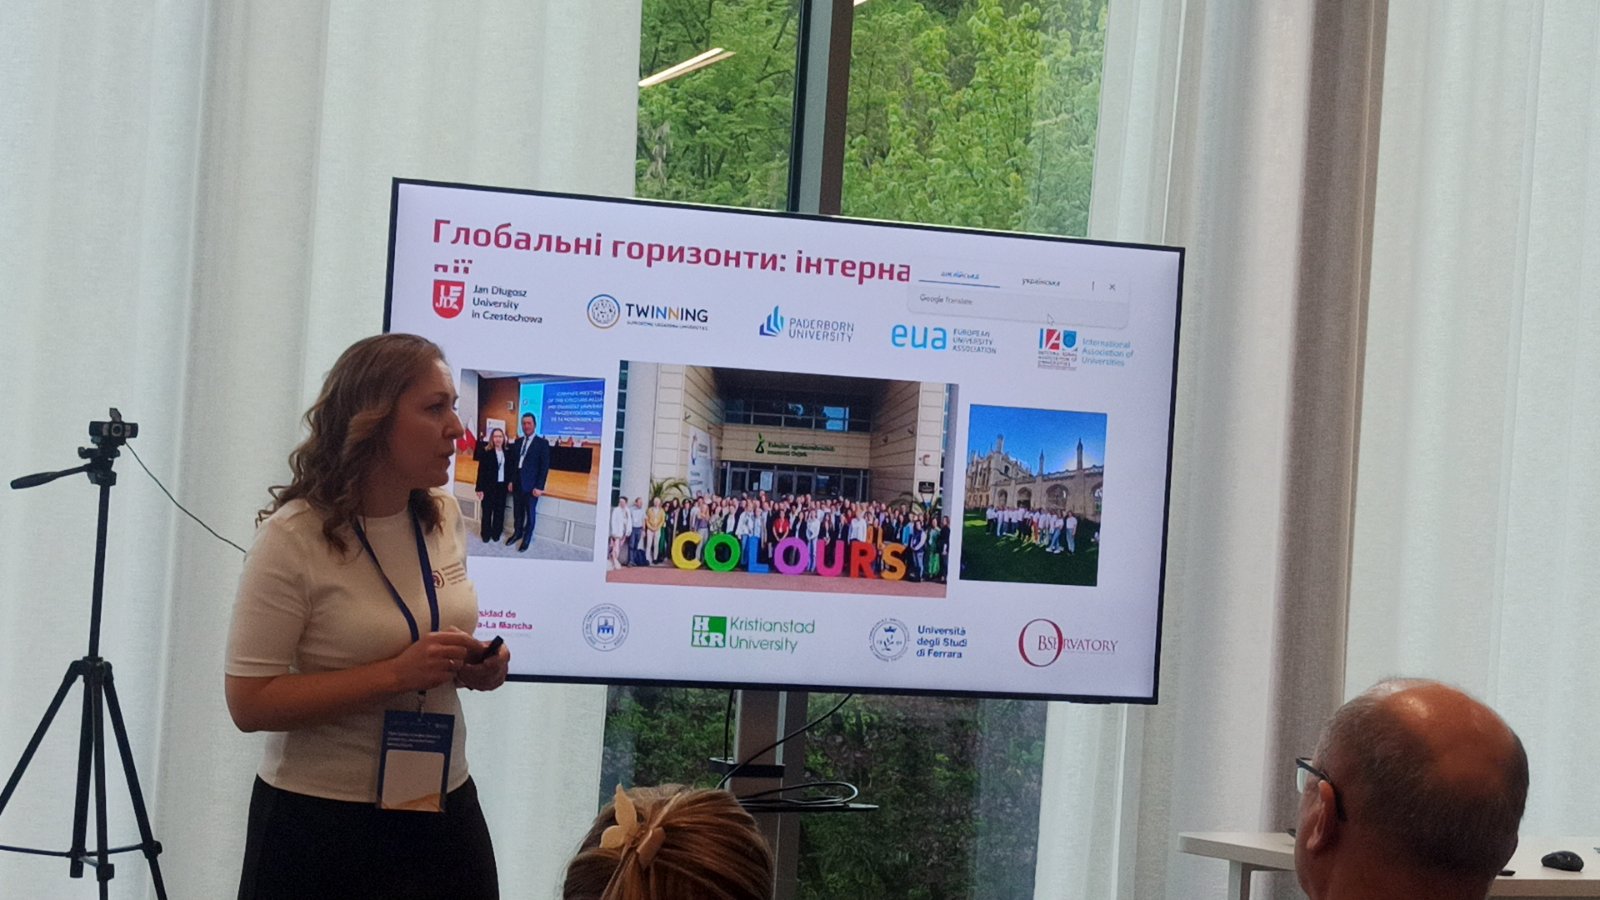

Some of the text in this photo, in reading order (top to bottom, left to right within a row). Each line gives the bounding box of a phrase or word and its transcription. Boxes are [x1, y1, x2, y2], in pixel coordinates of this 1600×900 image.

[433, 219, 911, 284] Глобальні горизонти: інтерна
[473, 285, 489, 294] Jan
[473, 297, 519, 311] University
[920, 293, 944, 304] Google
[472, 310, 480, 319] in
[625, 303, 708, 323] TWINNING
[789, 318, 854, 332] PADERBORN
[788, 331, 853, 343] UNIVERSITY
[891, 324, 947, 350] eua
[953, 328, 990, 337] EUROPEAN
[953, 337, 993, 346] UNIVERSITY
[1082, 338, 1131, 349] International
[952, 345, 997, 355] ASSOCIATION
[1081, 348, 1124, 358] Association
[671, 531, 906, 582] COLOURS
[478, 609, 516, 618] sidad de
[499, 621, 533, 630] Mancha
[730, 616, 815, 635] Kristianstad
[729, 635, 798, 654] University
[917, 637, 940, 647] degli
[927, 649, 962, 659] Ferrara
